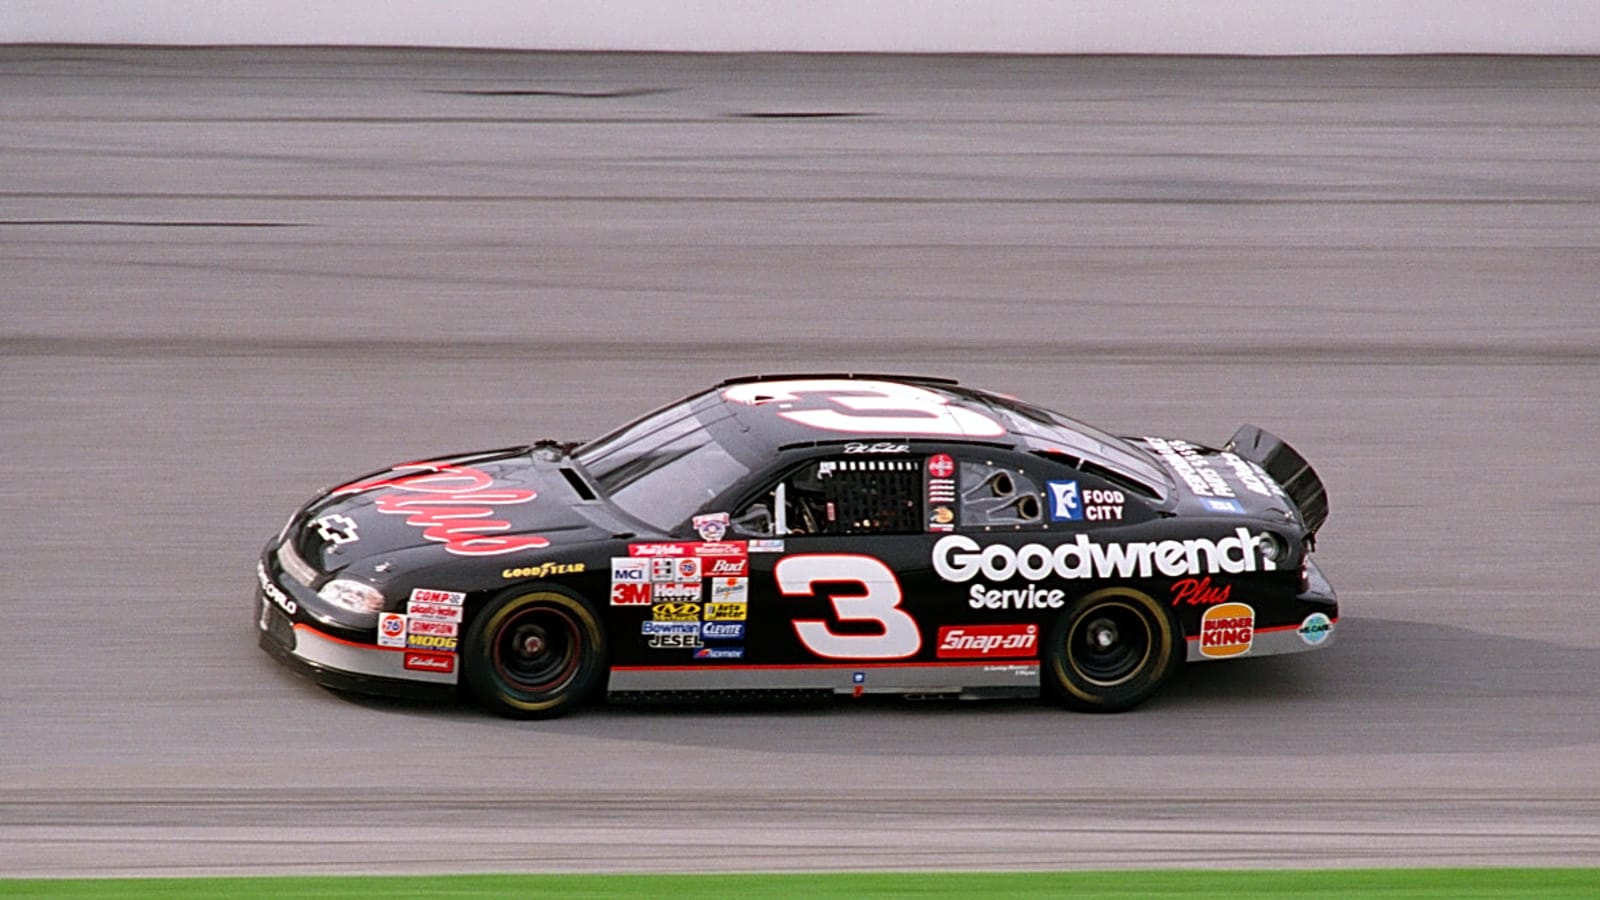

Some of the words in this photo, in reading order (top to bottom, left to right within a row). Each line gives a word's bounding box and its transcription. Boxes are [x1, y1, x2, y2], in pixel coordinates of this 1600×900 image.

[722, 379, 1006, 438] 3
[1083, 489, 1125, 504] FOOD
[332, 462, 550, 556] Plus
[1086, 506, 1124, 521] CITY
[932, 528, 1276, 583] Goodwrench
[502, 561, 586, 579] GOODYEAR
[711, 559, 747, 572] Bud
[614, 569, 643, 580] MCI
[415, 590, 450, 602] COMP
[612, 583, 652, 604] 3M
[654, 583, 701, 598] Holley
[968, 583, 1066, 609] Service
[1170, 576, 1232, 606] Plus
[716, 610, 745, 618] Meter
[774, 553, 922, 660] 3
[385, 620, 401, 631] 76
[412, 622, 454, 634] SIMPSON
[643, 621, 700, 634] Bowman
[1203, 617, 1253, 630] BURGER
[407, 634, 459, 649] MOOG
[651, 635, 703, 647] JESEL
[940, 629, 1037, 653] Snap-on
[1203, 629, 1252, 647] KING
